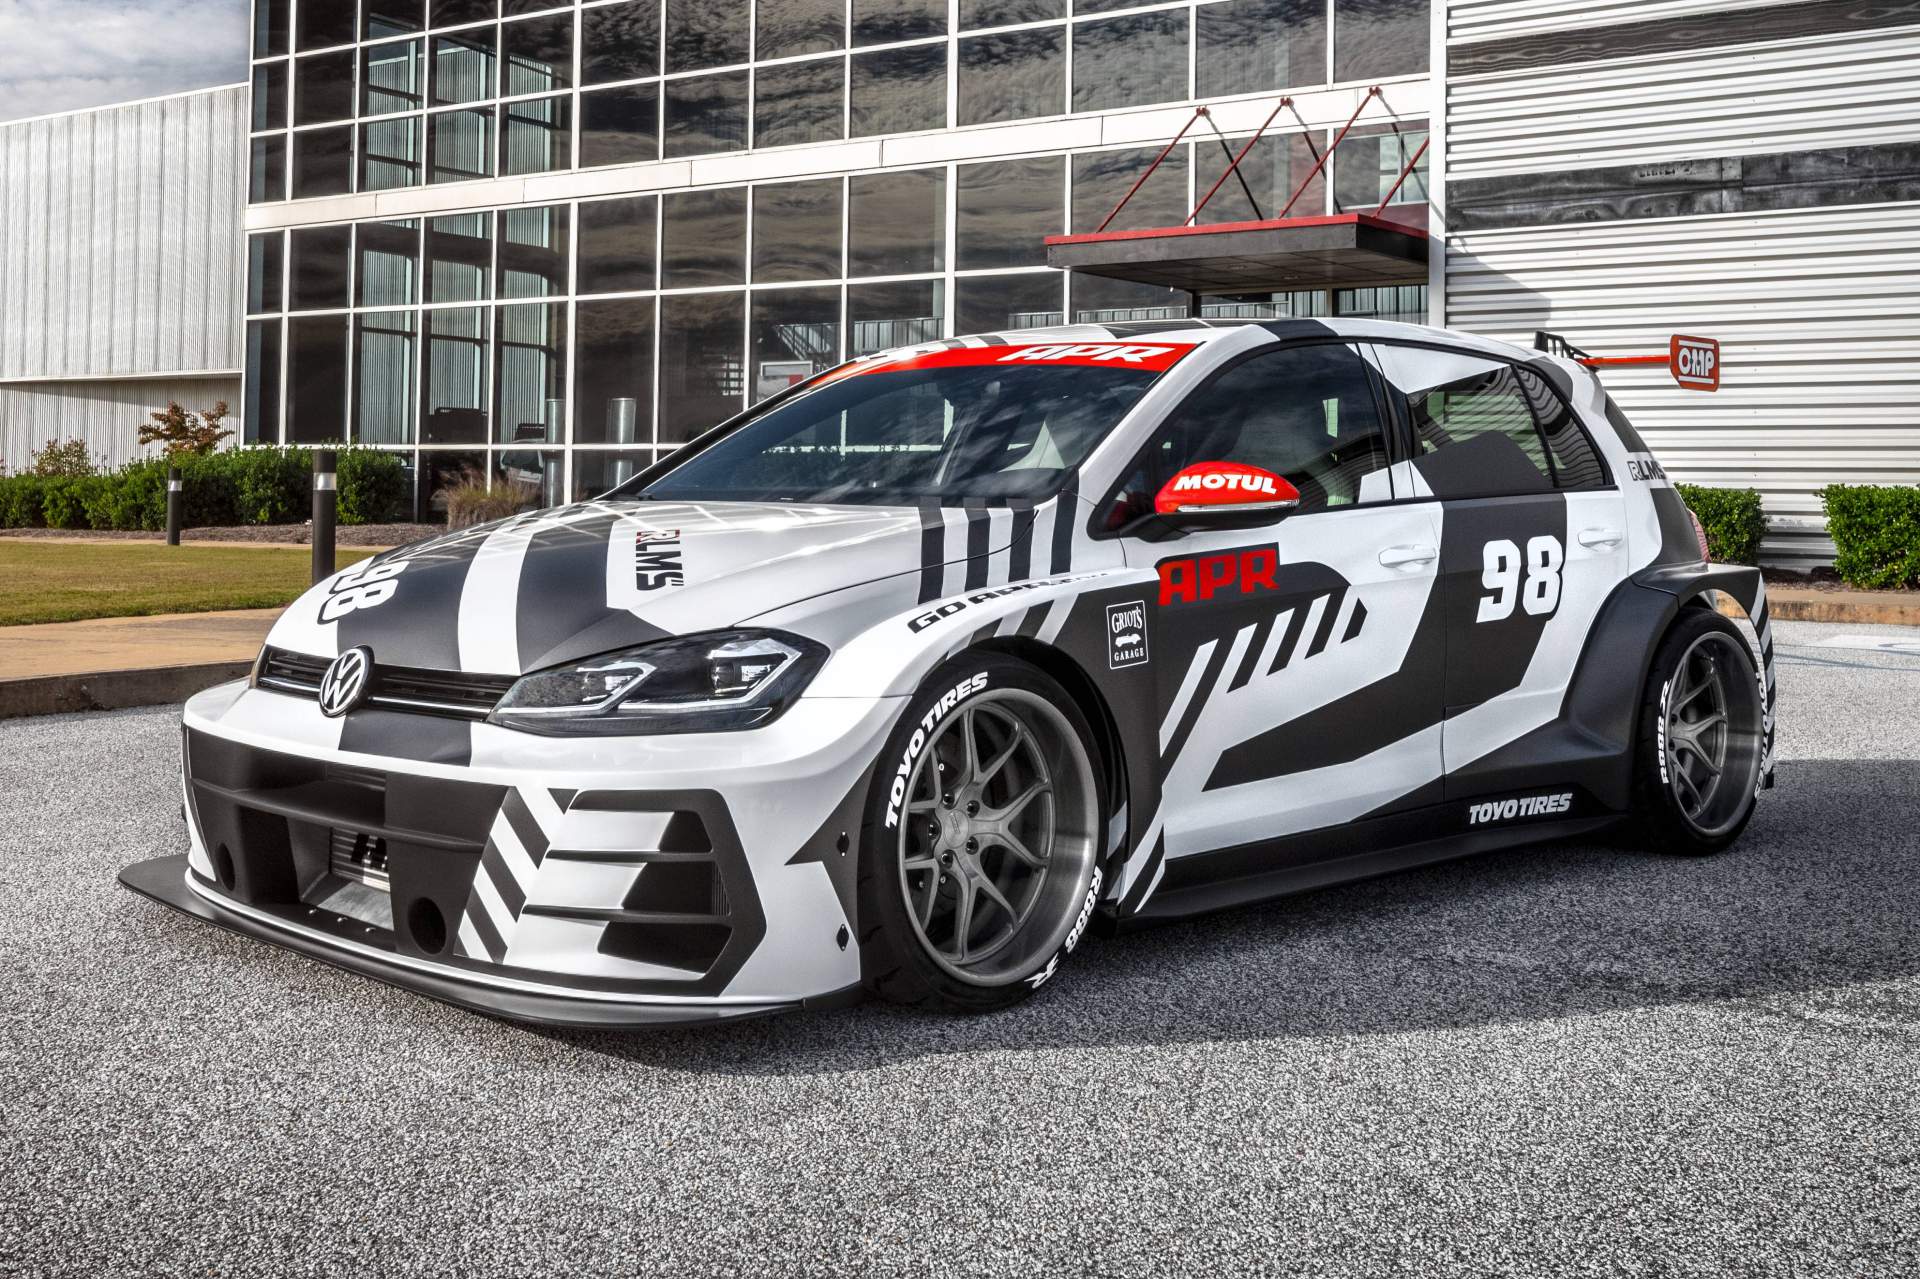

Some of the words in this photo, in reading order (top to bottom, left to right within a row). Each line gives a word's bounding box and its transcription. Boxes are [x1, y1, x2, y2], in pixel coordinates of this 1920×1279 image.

[995, 344, 1176, 363] APR
[1678, 347, 1715, 377] OMP
[1173, 474, 1277, 494] MOTUL
[317, 560, 410, 625] 98
[1157, 548, 1280, 606] APR
[1475, 534, 1563, 624] 98
[1111, 606, 1143, 633] GRIOT'S
[1114, 647, 1144, 661] GARAGE
[884, 728, 925, 829] TOYO
[921, 671, 989, 733] TIRES
[1469, 799, 1518, 825] TOYO
[1519, 793, 1573, 817] TIRES
